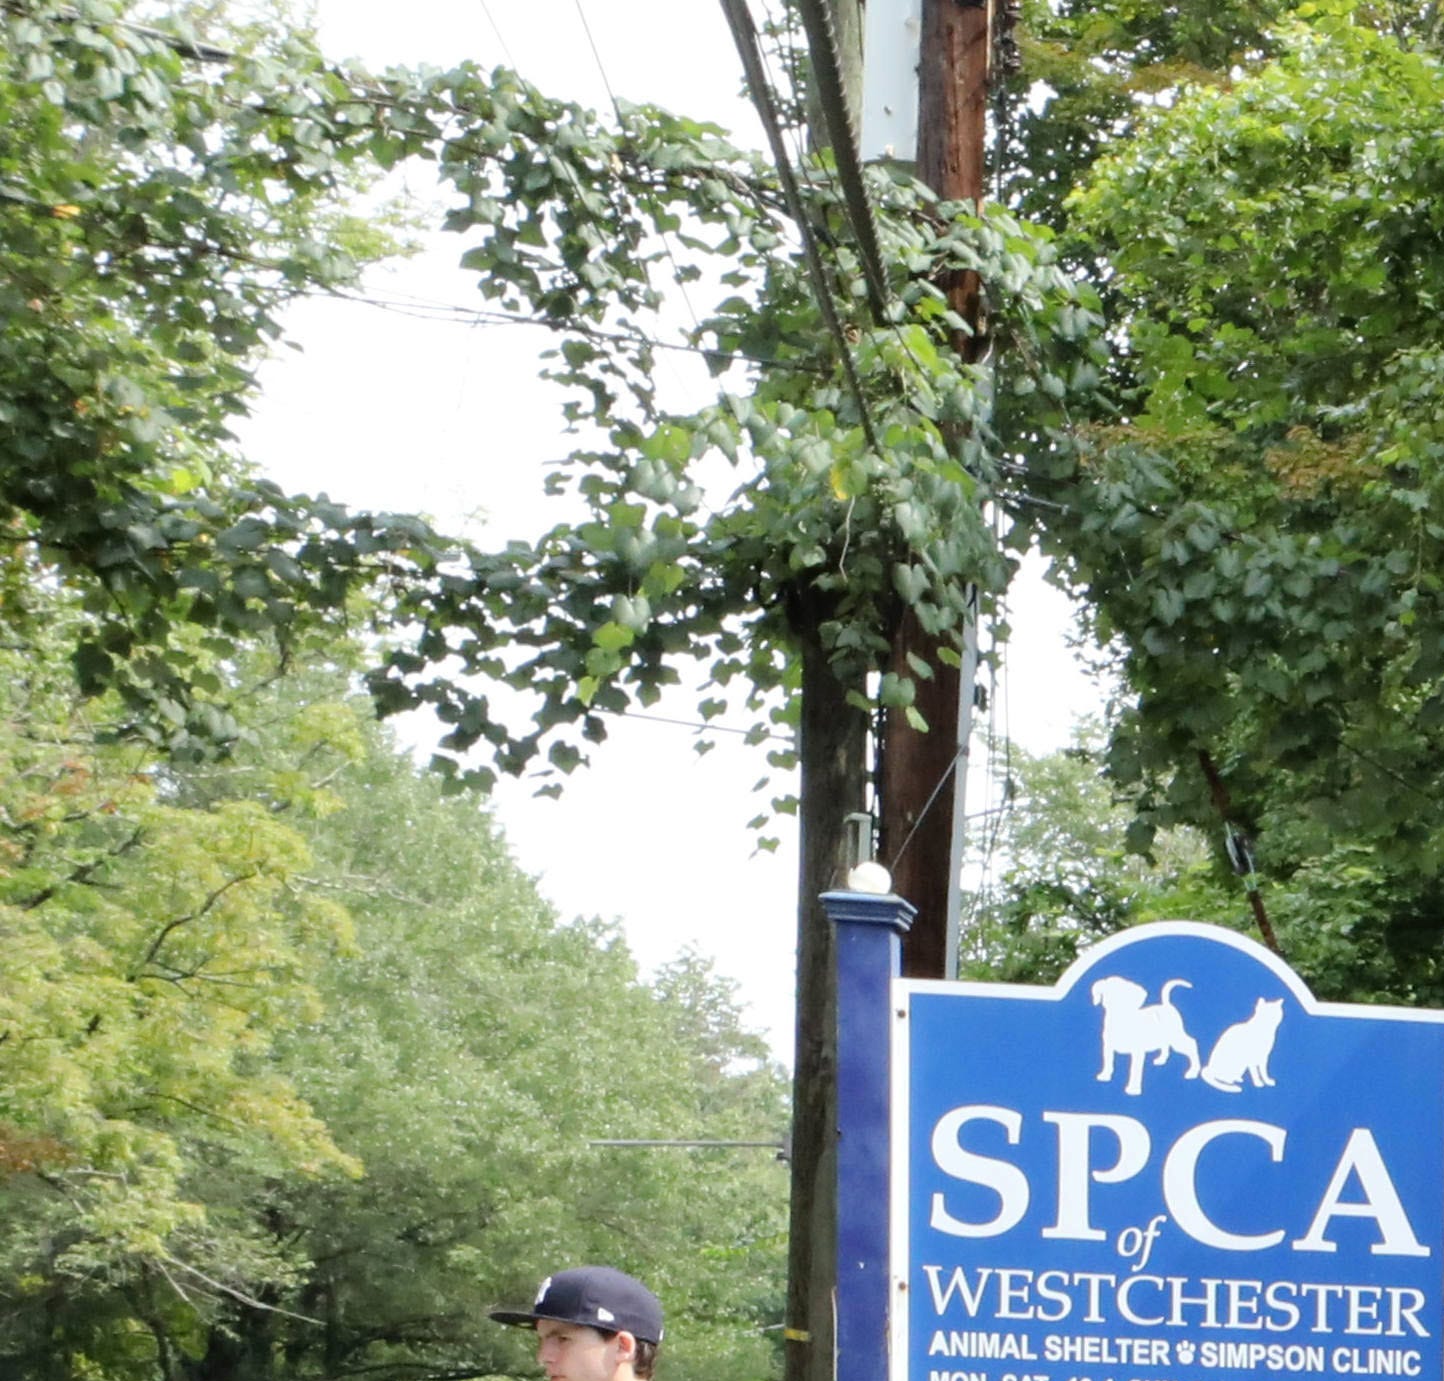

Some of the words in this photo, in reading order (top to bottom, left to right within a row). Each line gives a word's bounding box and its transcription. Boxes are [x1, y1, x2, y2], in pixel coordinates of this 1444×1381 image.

[930, 1104, 1431, 1257] SPCA
[1116, 1214, 1167, 1271] of
[922, 1264, 1431, 1337] WESTCHESTER
[928, 1330, 1037, 1360] ANIMAL
[1044, 1334, 1171, 1365] SHELTER
[1200, 1341, 1324, 1372] SIMPSON
[1332, 1347, 1421, 1376] CLINIC
